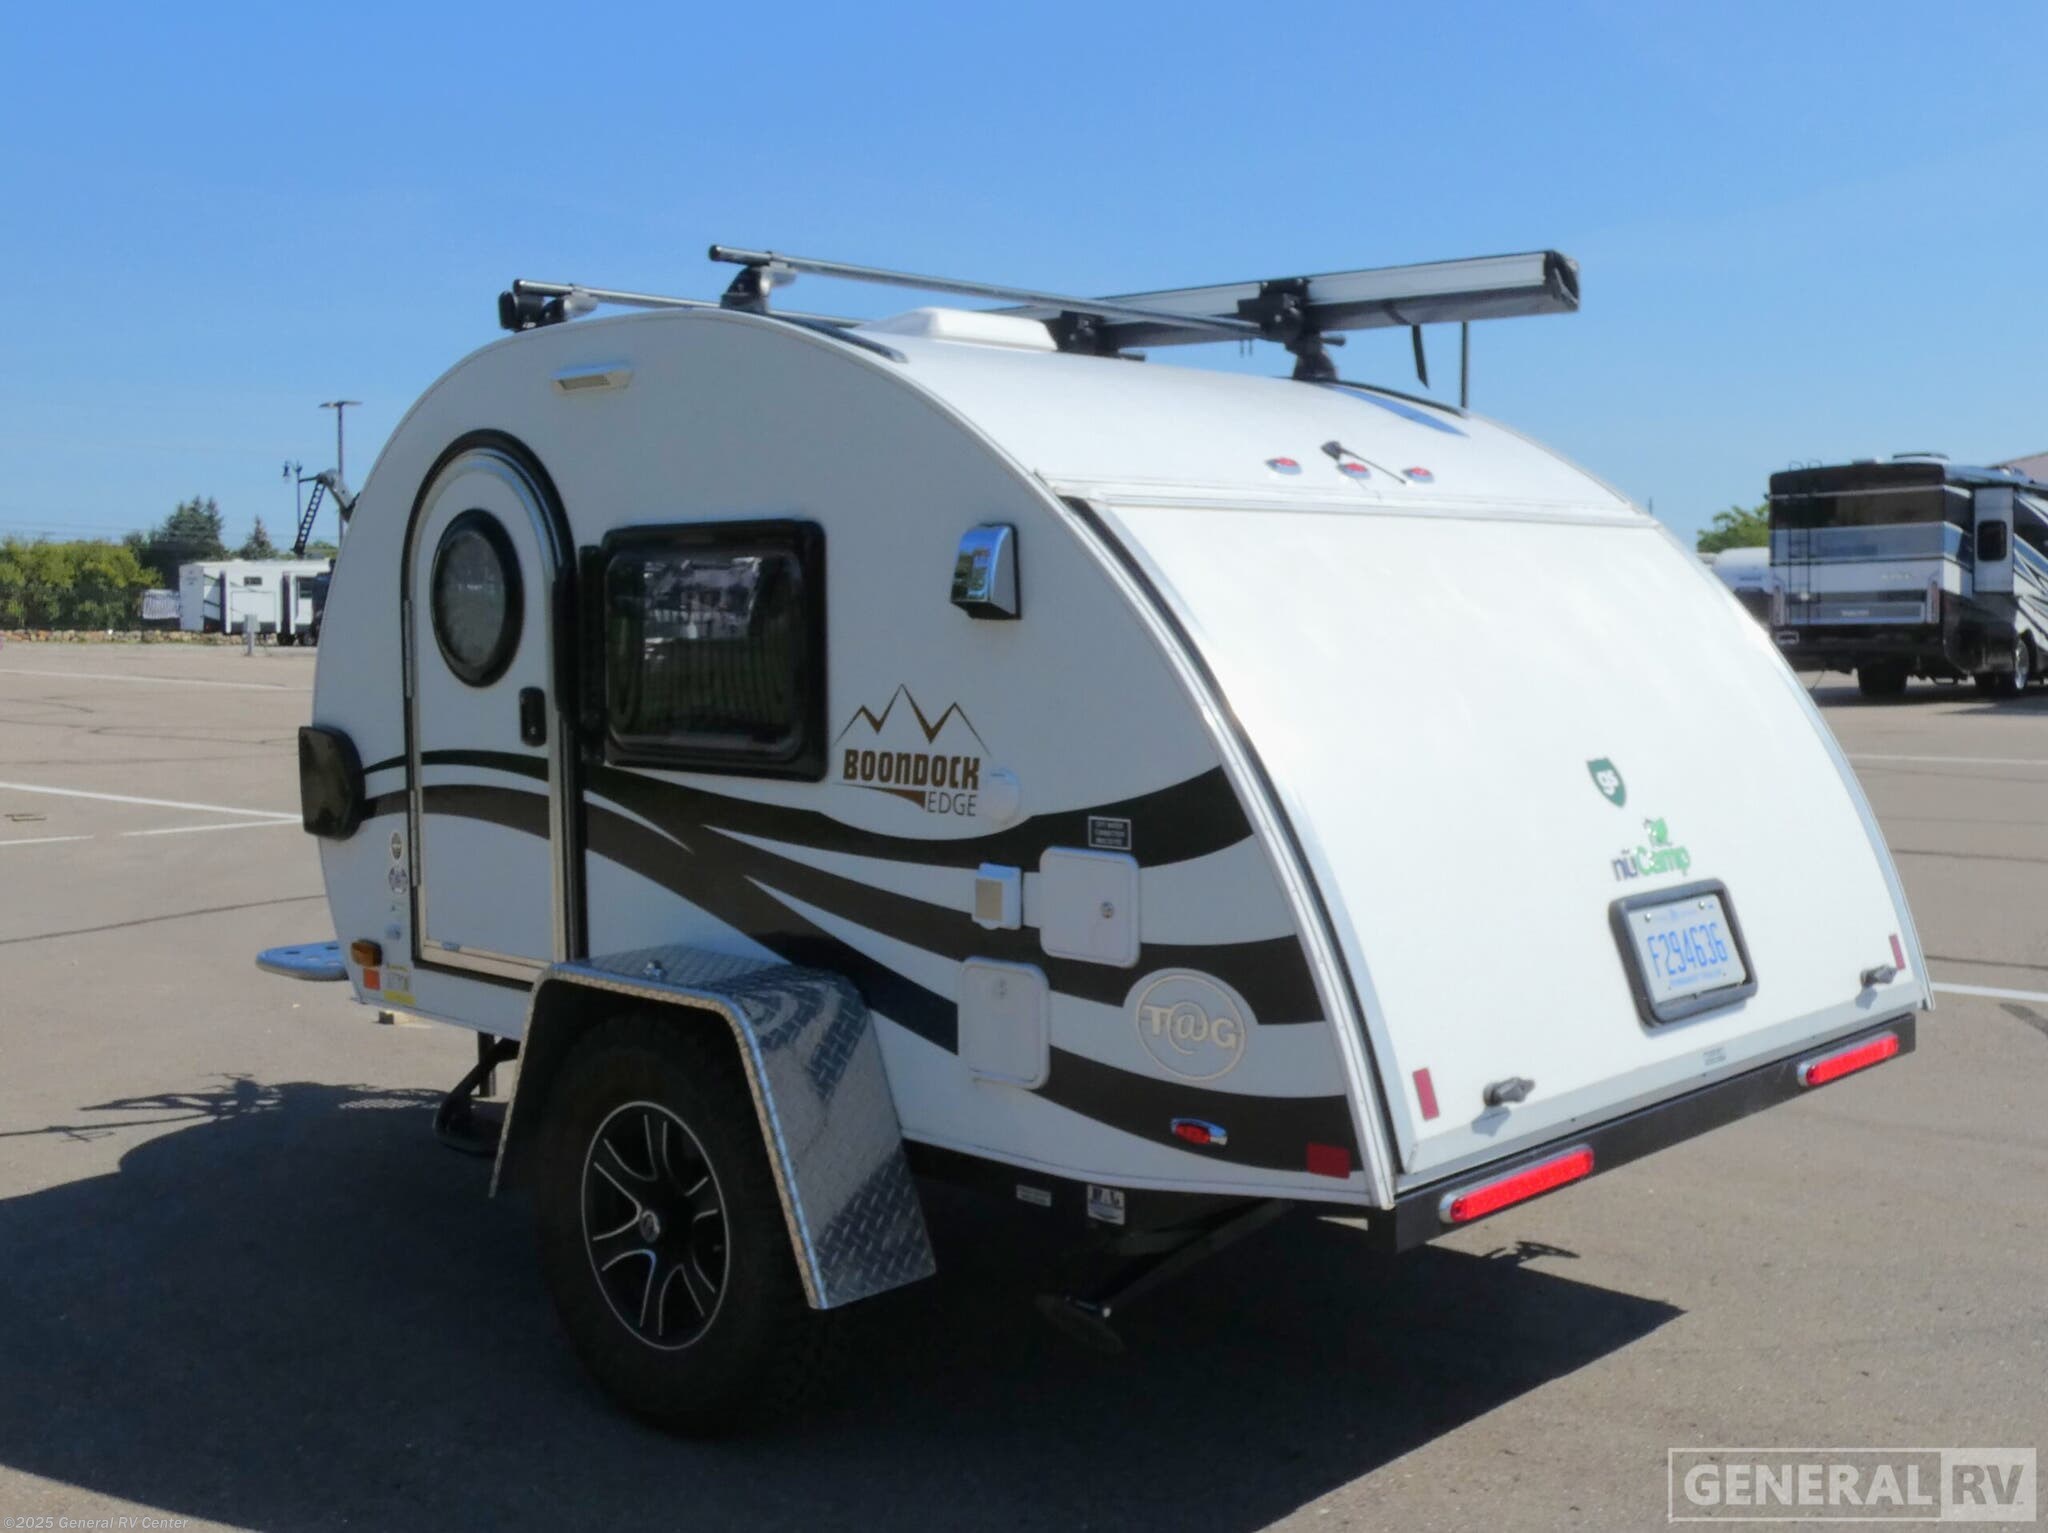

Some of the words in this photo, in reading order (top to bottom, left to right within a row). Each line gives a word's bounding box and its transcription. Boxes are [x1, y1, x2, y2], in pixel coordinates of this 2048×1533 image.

[843, 748, 981, 790] BOONDOCK
[926, 791, 977, 817] EDGE
[1647, 922, 1728, 977] F294636
[1142, 1000, 1237, 1056] T@G
